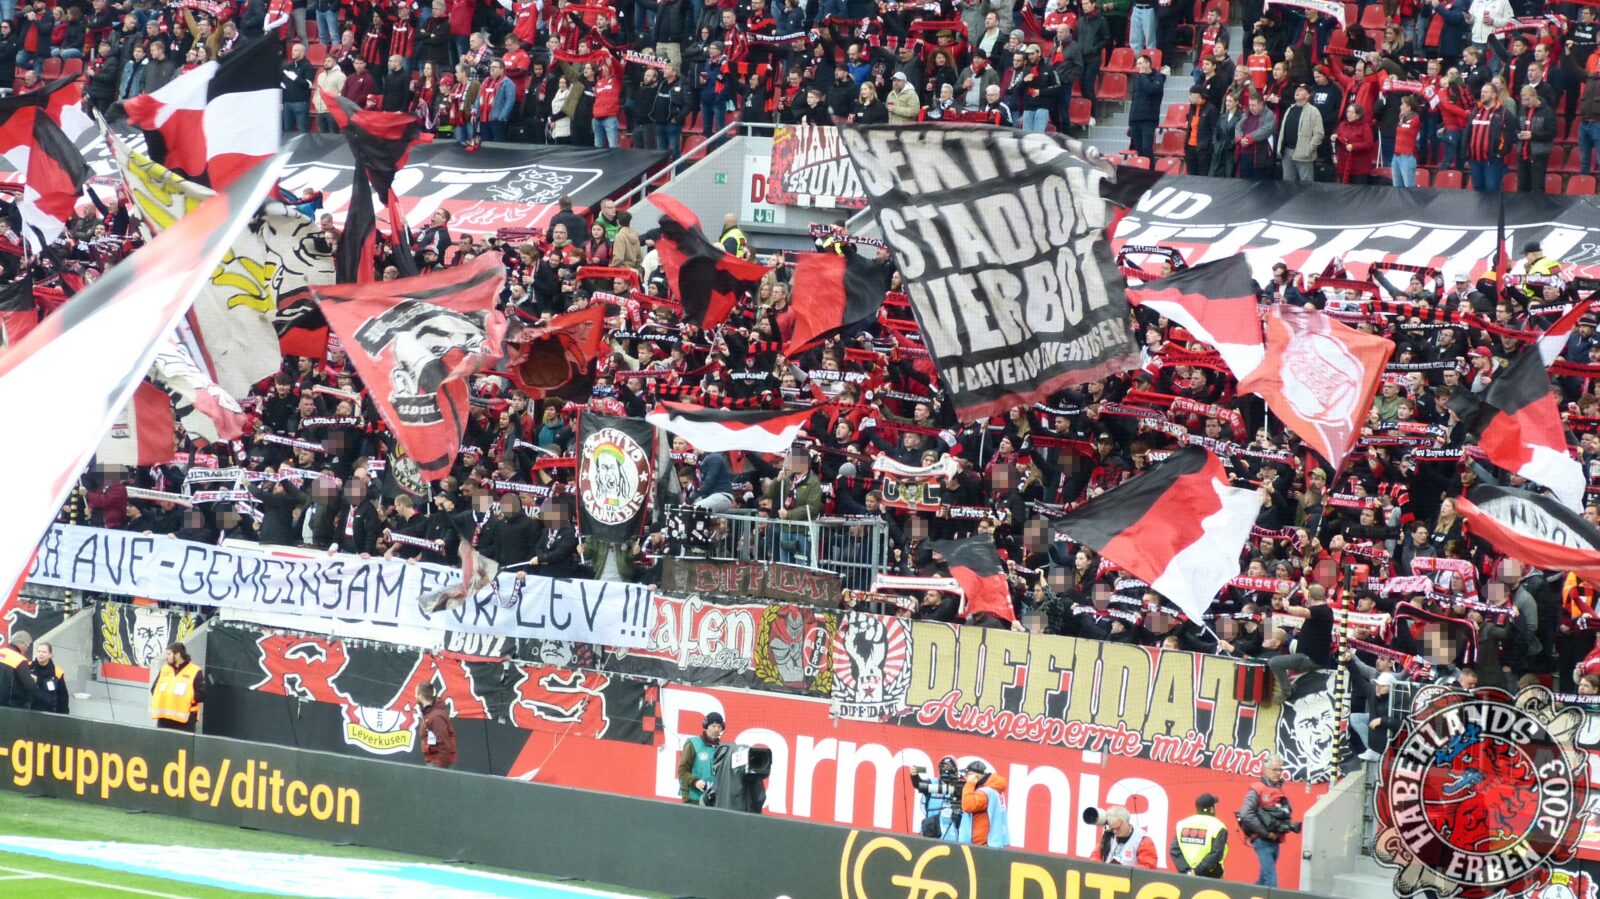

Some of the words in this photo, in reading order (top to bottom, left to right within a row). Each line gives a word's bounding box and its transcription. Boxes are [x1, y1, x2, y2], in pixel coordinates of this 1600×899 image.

[880, 167, 1106, 280] STADION
[909, 229, 1110, 358] VERBOT
[731, 369, 769, 380] werkself
[1426, 448, 1444, 457] Bayer
[582, 489, 645, 523] CANNABIS
[179, 546, 405, 617] GEMEINSAM
[352, 727, 406, 746] Leverkusen
[917, 690, 1141, 757] Ausgesperrte
[1149, 731, 1205, 768] mit
[656, 685, 1169, 868] Barmnia
